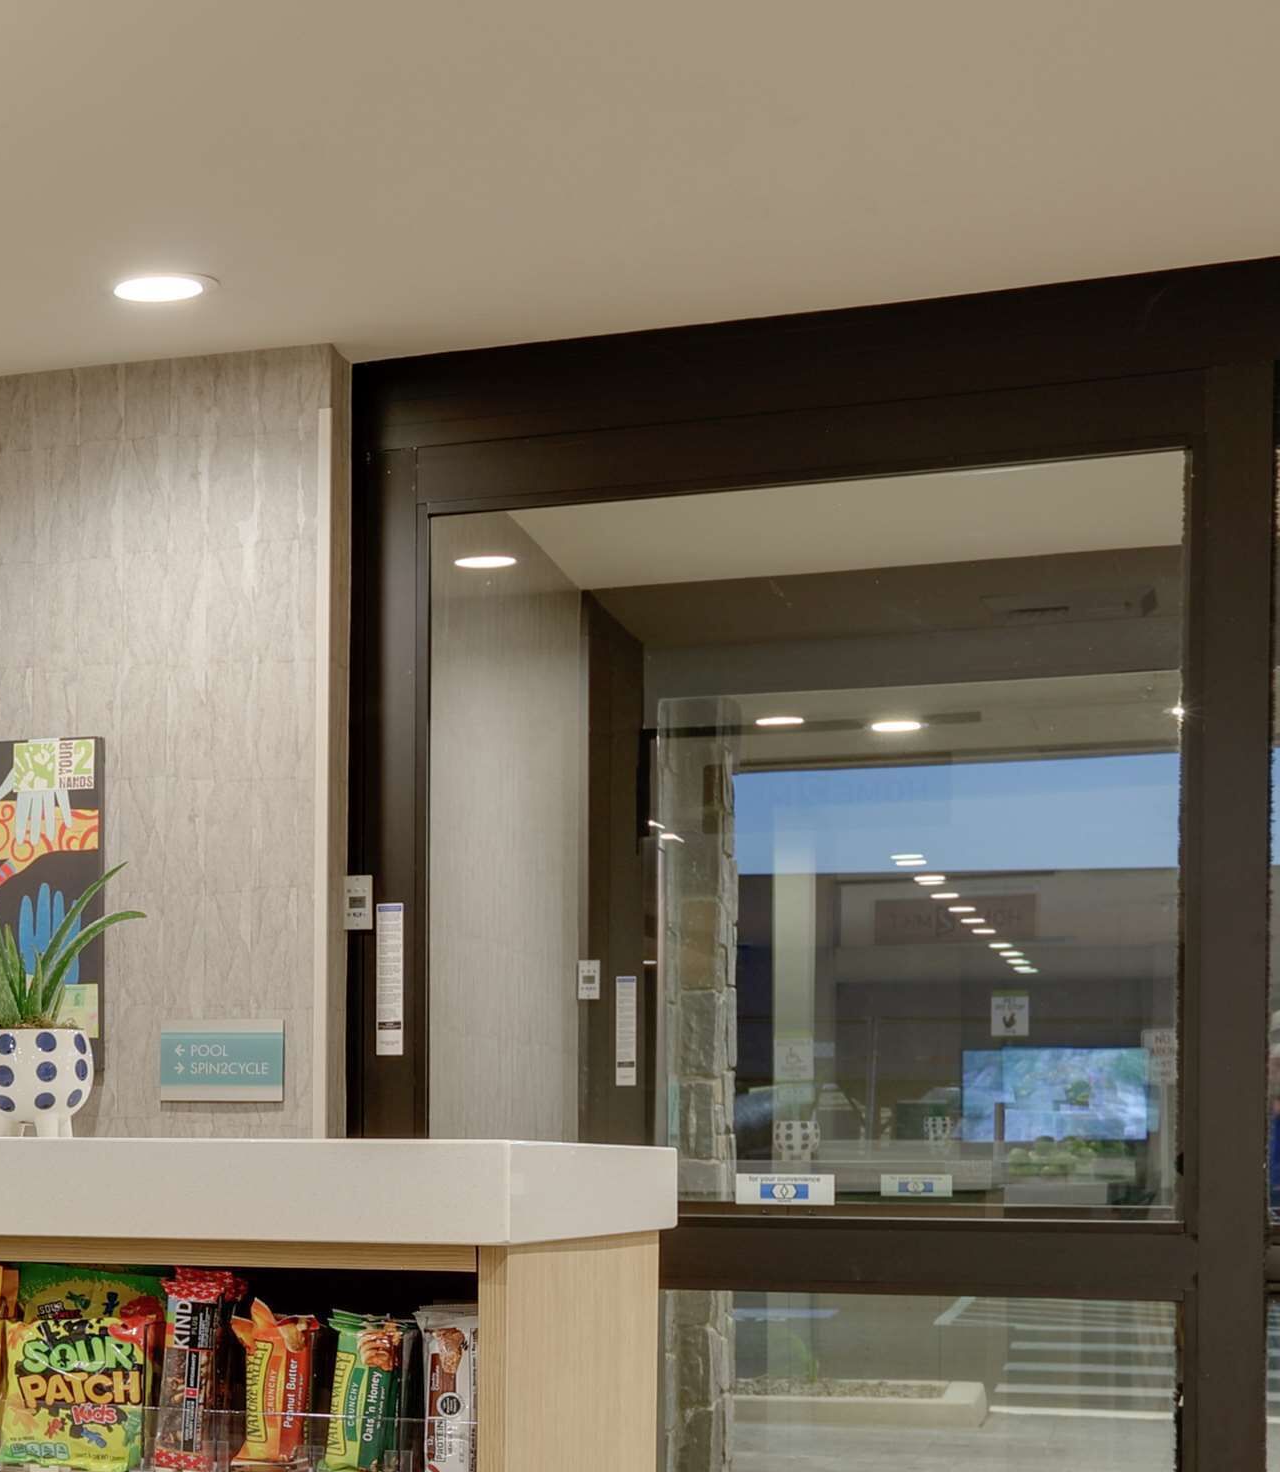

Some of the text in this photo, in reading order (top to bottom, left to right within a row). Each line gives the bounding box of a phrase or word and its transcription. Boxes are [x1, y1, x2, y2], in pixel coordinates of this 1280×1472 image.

[58, 742, 73, 776] YOUR
[73, 741, 93, 776] 2
[59, 776, 93, 788] HANDS
[191, 1044, 228, 1057] POOL
[190, 1062, 269, 1075] SPIN2CYCLE
[174, 1301, 192, 1348] KIND
[23, 1337, 134, 1373] SOUR
[20, 1371, 142, 1408] PATCH
[283, 1359, 297, 1428] Peanut Butter
[362, 1371, 382, 1442] Oats Honey
[72, 1404, 117, 1425] Kids
[436, 1422, 445, 1459] PROTEIN
